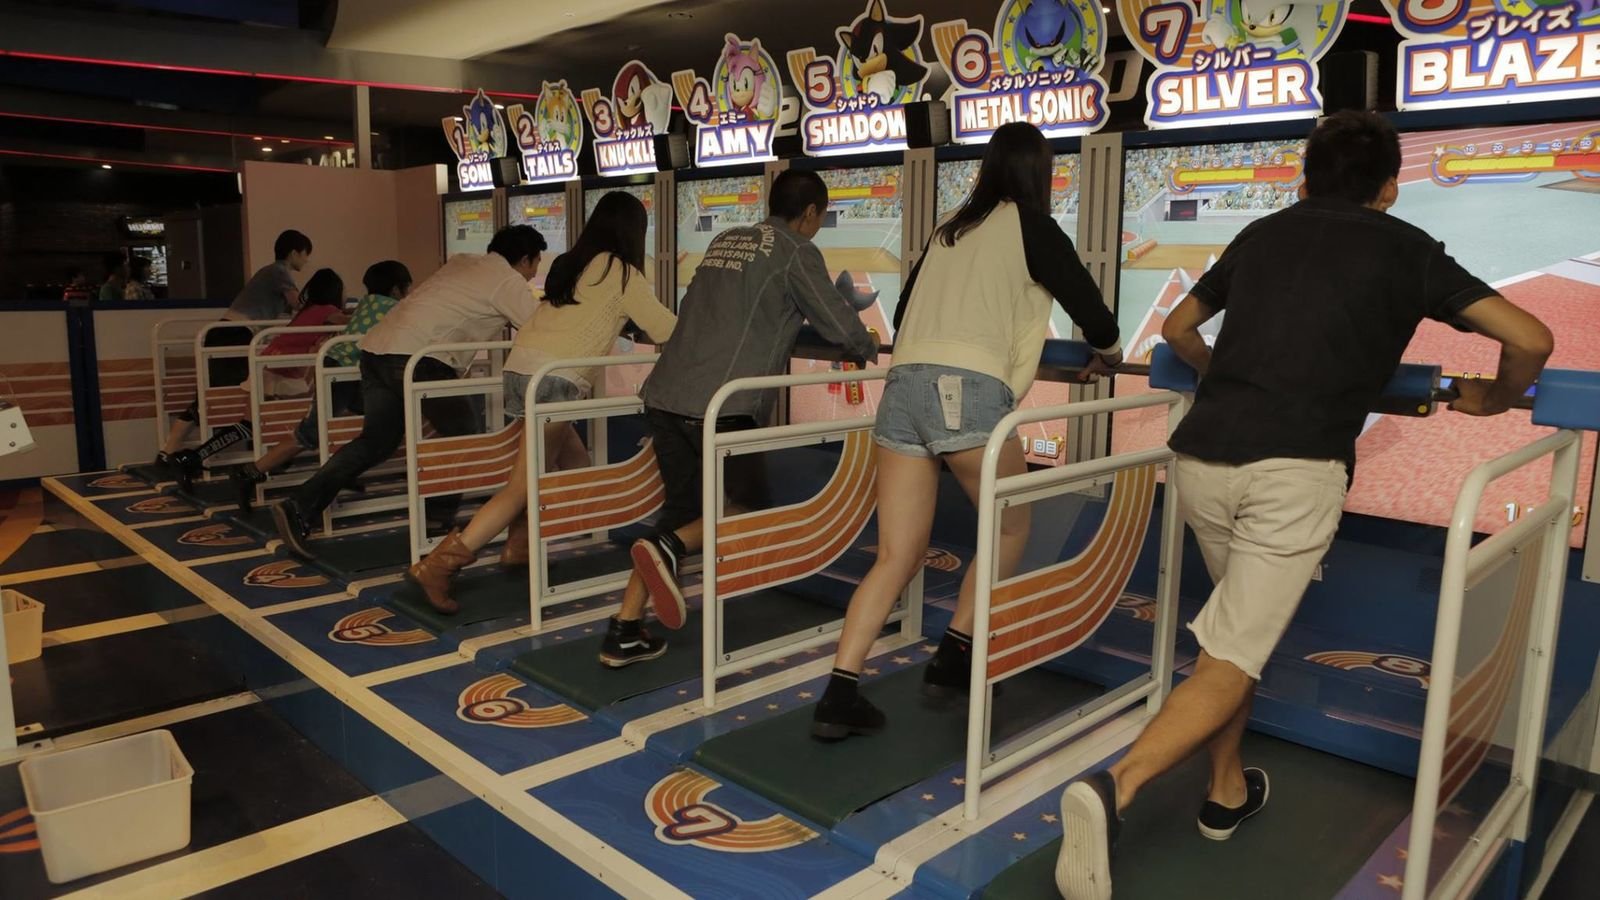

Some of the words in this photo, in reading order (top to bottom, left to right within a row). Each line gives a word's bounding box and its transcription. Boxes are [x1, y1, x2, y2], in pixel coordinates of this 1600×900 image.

[1145, 8, 1185, 57] 7
[1470, 6, 1574, 39] ブレイズ
[955, 42, 985, 81] 6
[1193, 46, 1274, 71] シルバー
[1409, 32, 1600, 95] BLAZE
[808, 64, 832, 102] 5
[990, 69, 1076, 92] メタルソニック
[1159, 65, 1310, 115] SILVER
[594, 100, 611, 133] 3
[689, 84, 710, 118] 4
[837, 95, 878, 112] シャドウ
[960, 92, 1028, 130] METAL
[1030, 86, 1098, 125] SONIC
[518, 116, 533, 147] 2
[719, 111, 747, 125] エミー
[809, 108, 907, 146] SHADOW
[453, 126, 464, 156] 1
[599, 140, 656, 167] KNUCKLE
[700, 124, 770, 158] AMY
[460, 163, 493, 184] SONI
[526, 153, 574, 177] TAILS
[664, 805, 735, 838] 7
